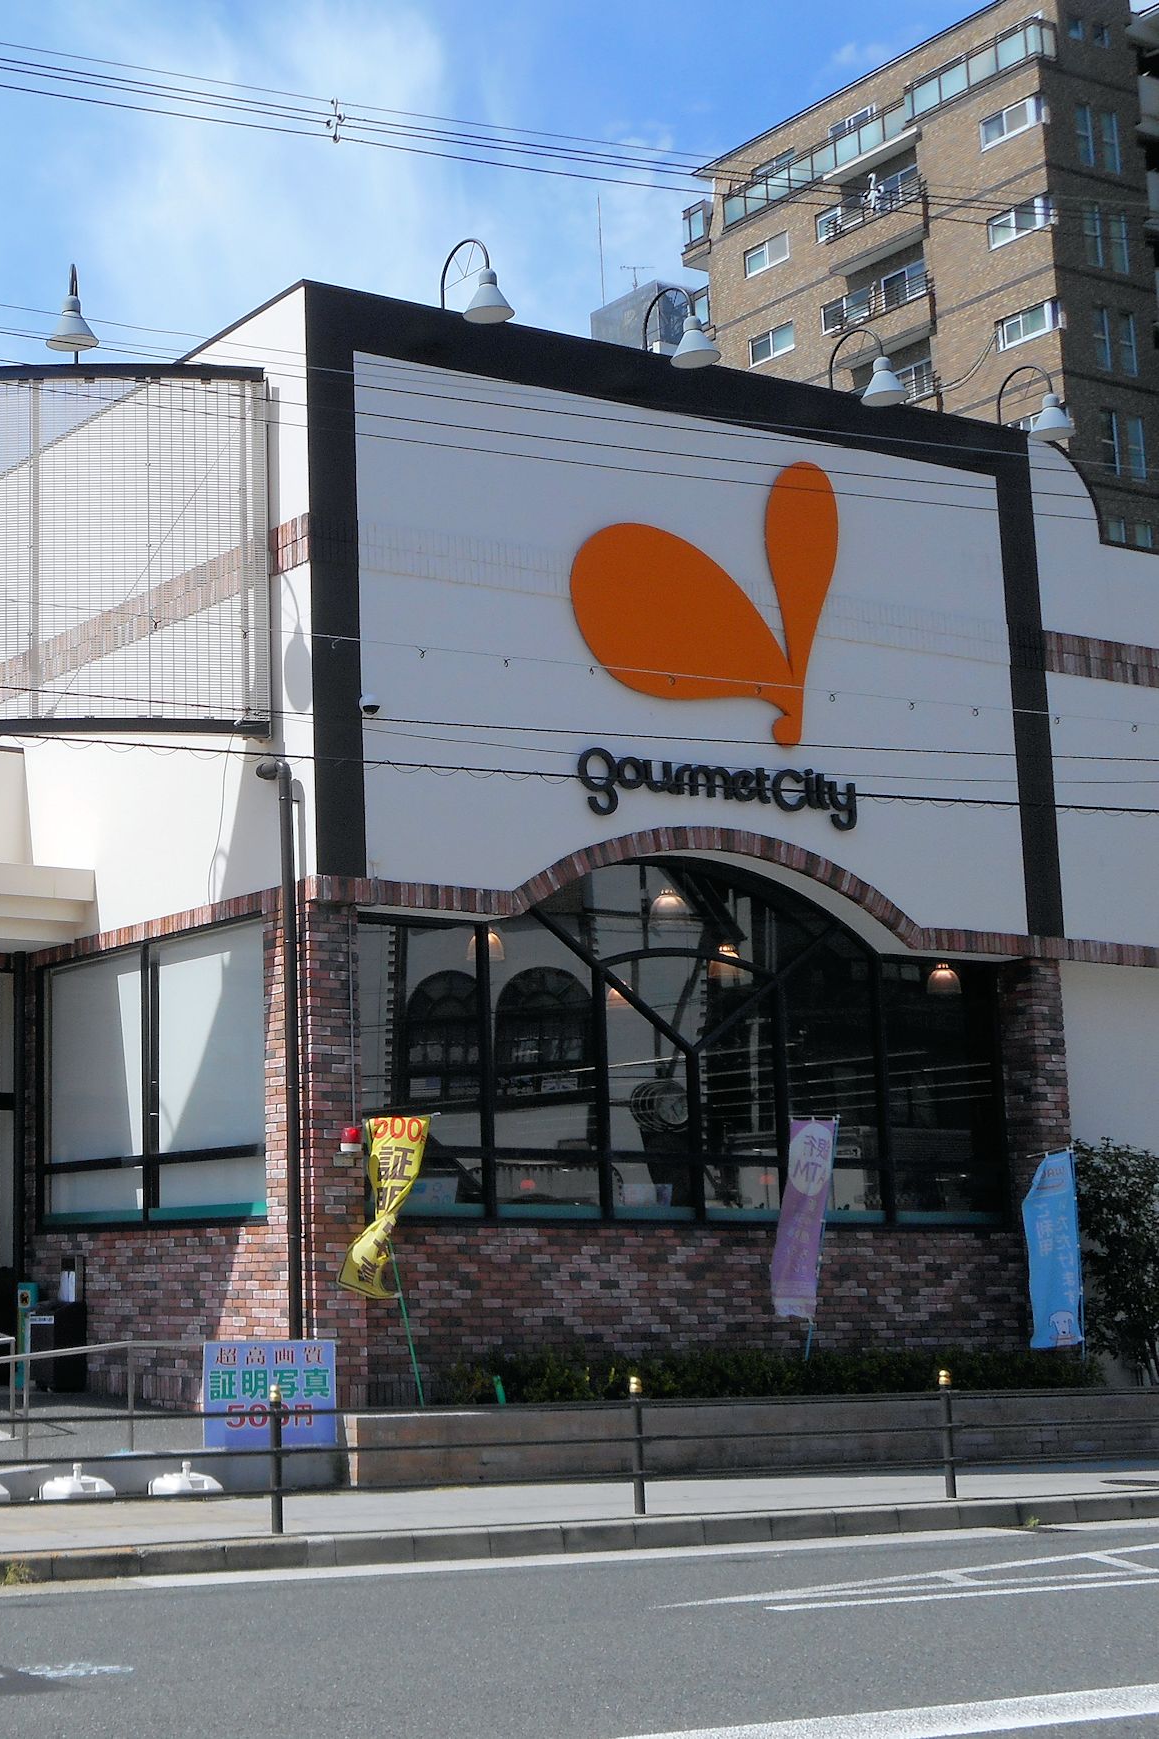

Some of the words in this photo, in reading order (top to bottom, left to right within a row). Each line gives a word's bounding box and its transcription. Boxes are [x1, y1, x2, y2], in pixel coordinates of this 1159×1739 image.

[216, 1346, 324, 1366] 超高画質
[209, 1368, 330, 1401] 証明写真
